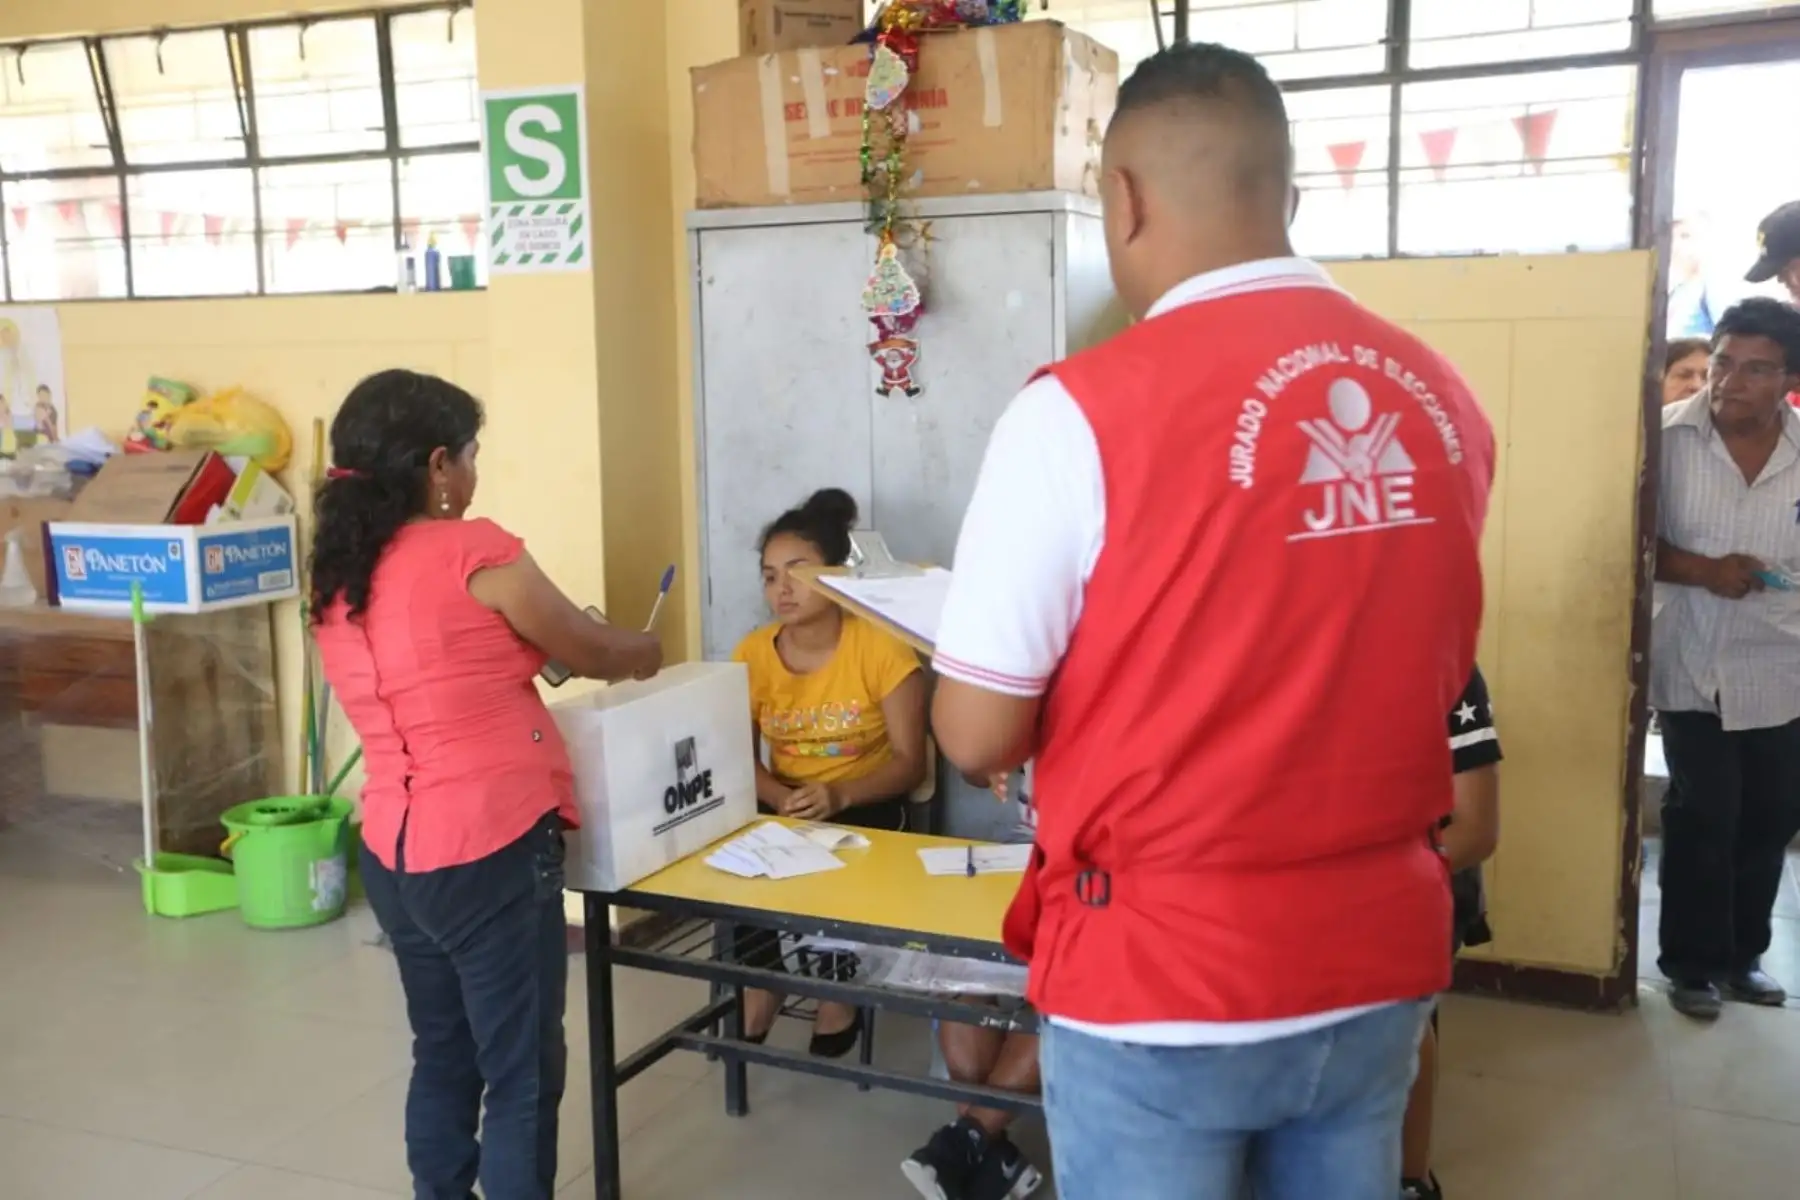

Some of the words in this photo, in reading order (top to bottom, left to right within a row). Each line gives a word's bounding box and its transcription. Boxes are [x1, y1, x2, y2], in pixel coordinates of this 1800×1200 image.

[504, 104, 566, 197] S
[1229, 397, 1267, 489] JURADO
[1256, 341, 1350, 399] NACIONAL
[1353, 344, 1379, 370] DE
[1384, 357, 1463, 465] ELECCIONES
[1304, 475, 1416, 531] JNE
[85, 547, 167, 574] PANETÓN
[224, 540, 287, 564] PANETÓN
[664, 768, 713, 814] ONPE
